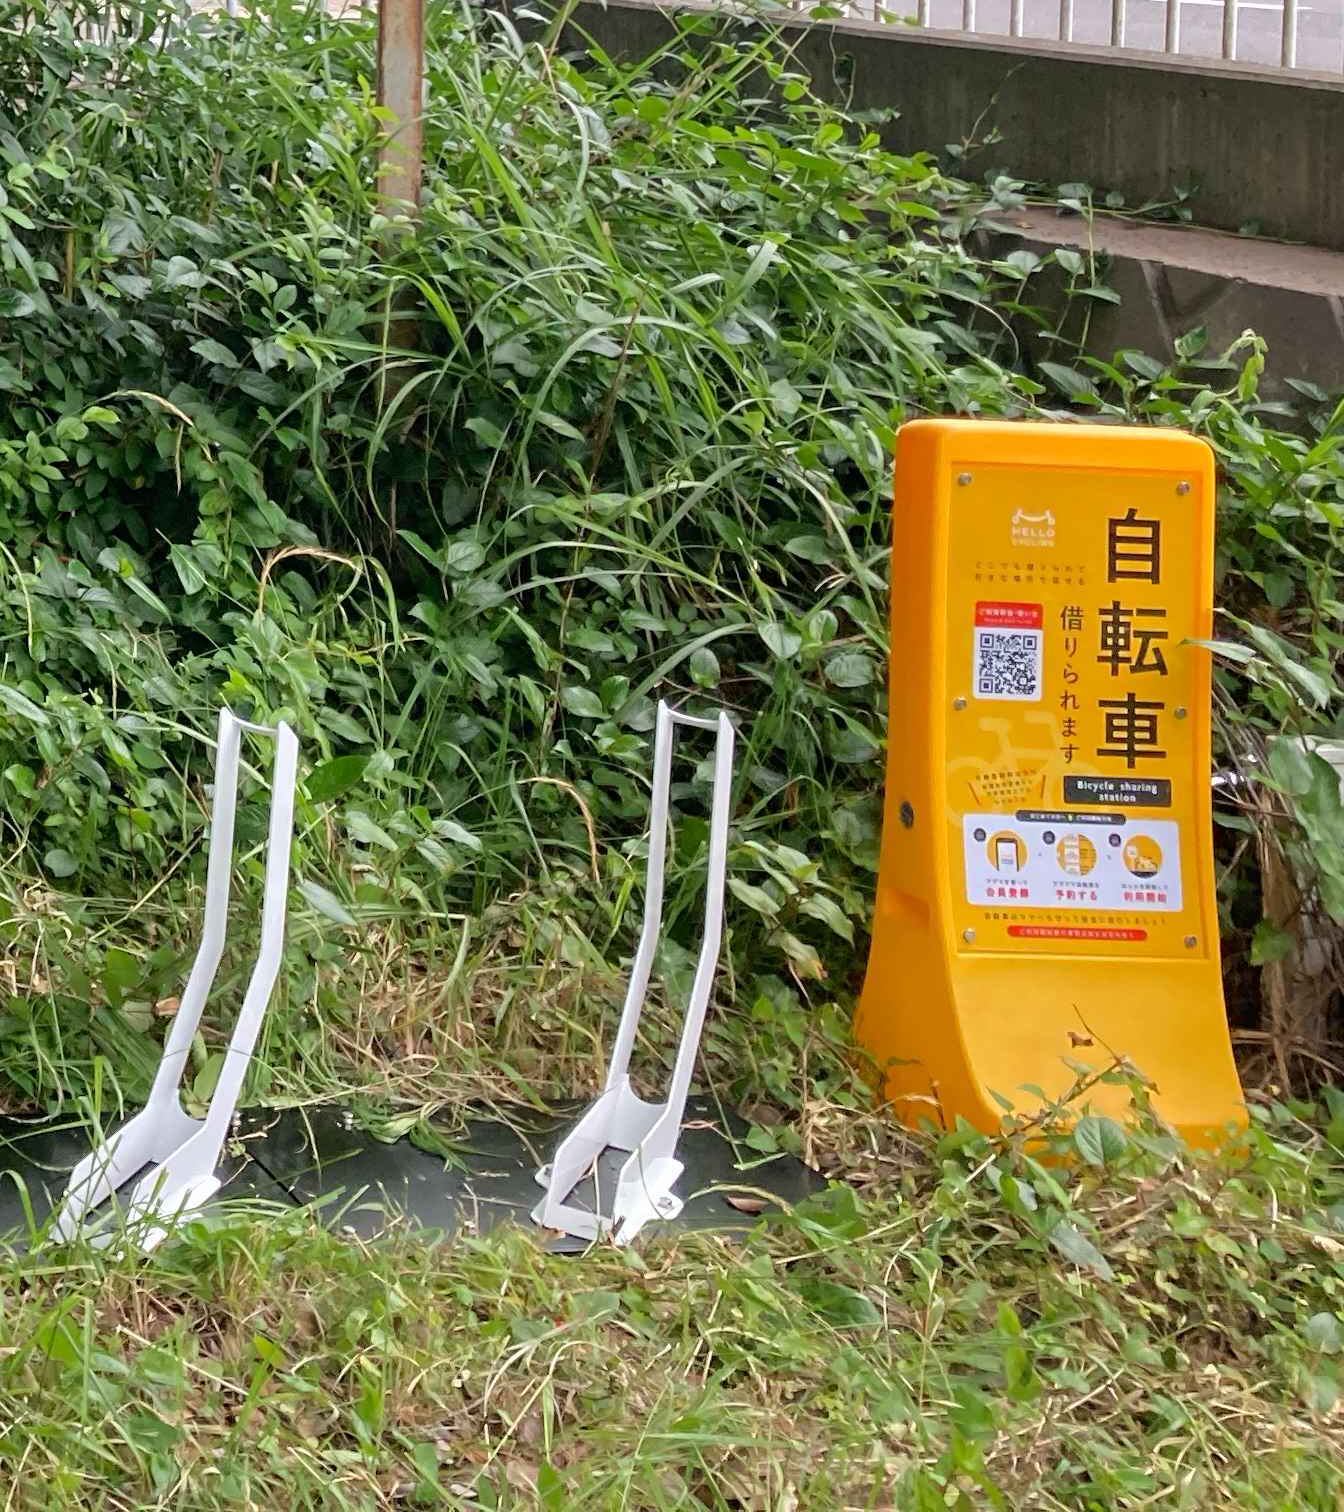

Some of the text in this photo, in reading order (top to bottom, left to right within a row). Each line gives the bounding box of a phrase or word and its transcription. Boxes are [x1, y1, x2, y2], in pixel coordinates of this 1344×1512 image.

[1011, 526, 1056, 537] HELLO
[1096, 507, 1169, 770] 自転車
[1059, 605, 1085, 764] 借りられます
[1076, 780, 1159, 796] Bicycle sharing
[1098, 793, 1137, 803] station
